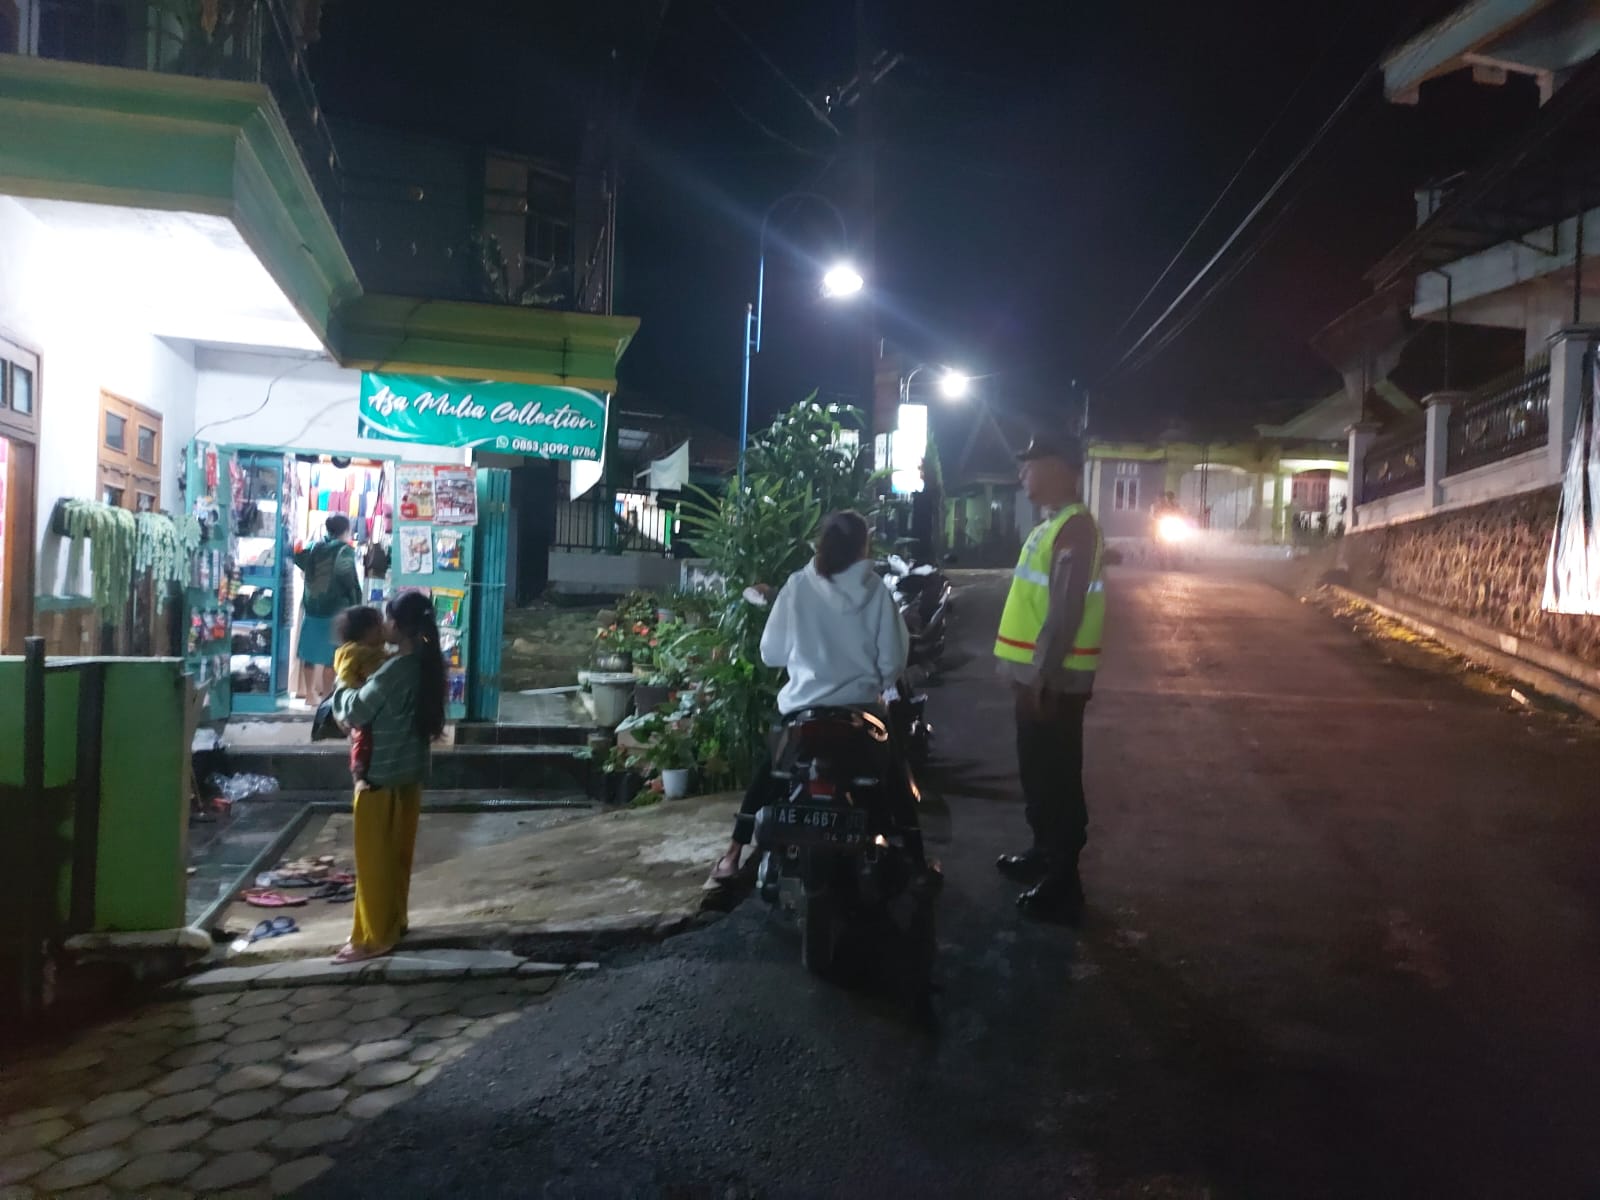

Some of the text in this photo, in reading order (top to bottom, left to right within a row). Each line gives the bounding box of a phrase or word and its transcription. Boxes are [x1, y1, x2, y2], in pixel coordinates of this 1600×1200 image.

[413, 391, 487, 420] Mulia
[490, 401, 597, 429] Collection
[778, 807, 797, 824] AE
